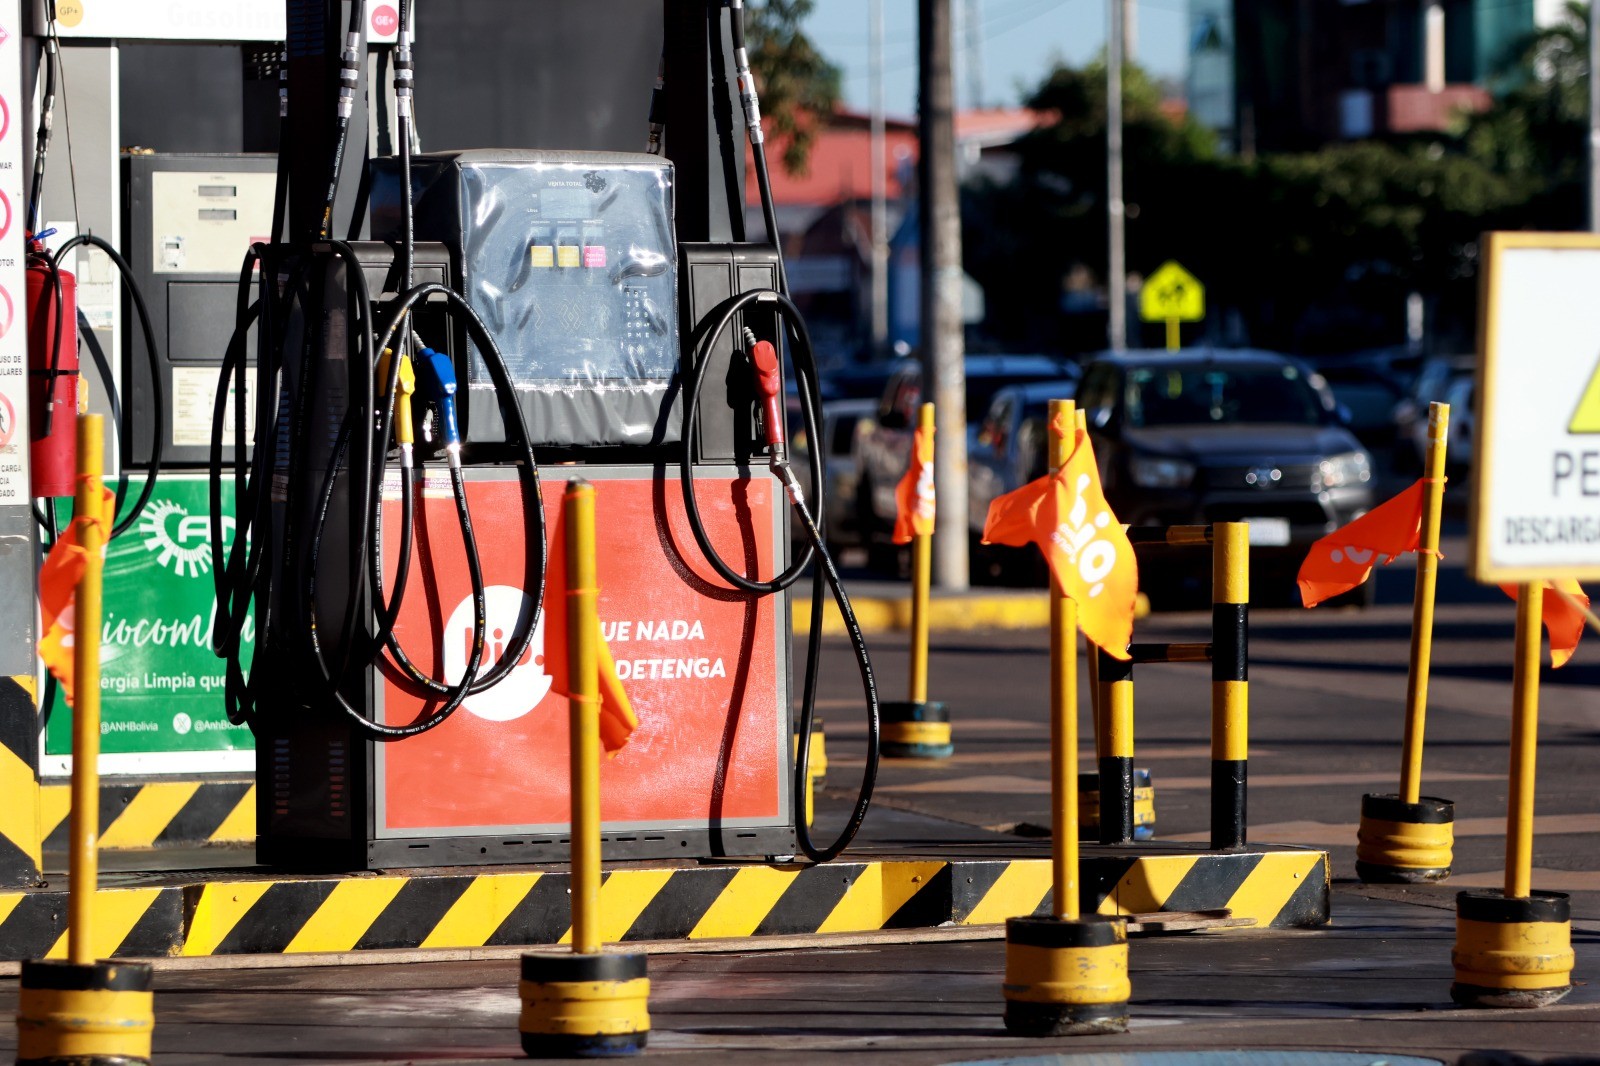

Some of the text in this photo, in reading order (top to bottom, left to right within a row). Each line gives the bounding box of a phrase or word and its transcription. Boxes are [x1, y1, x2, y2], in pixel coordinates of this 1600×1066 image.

[59, 6, 78, 16] GP+
[375, 14, 395, 26] GE+
[13, 355, 22, 363] DE
[1505, 516, 1600, 544] DESCARG
[600, 620, 705, 642] UE NADA
[615, 657, 726, 680] DETENGA
[144, 671, 196, 693] Limpia
